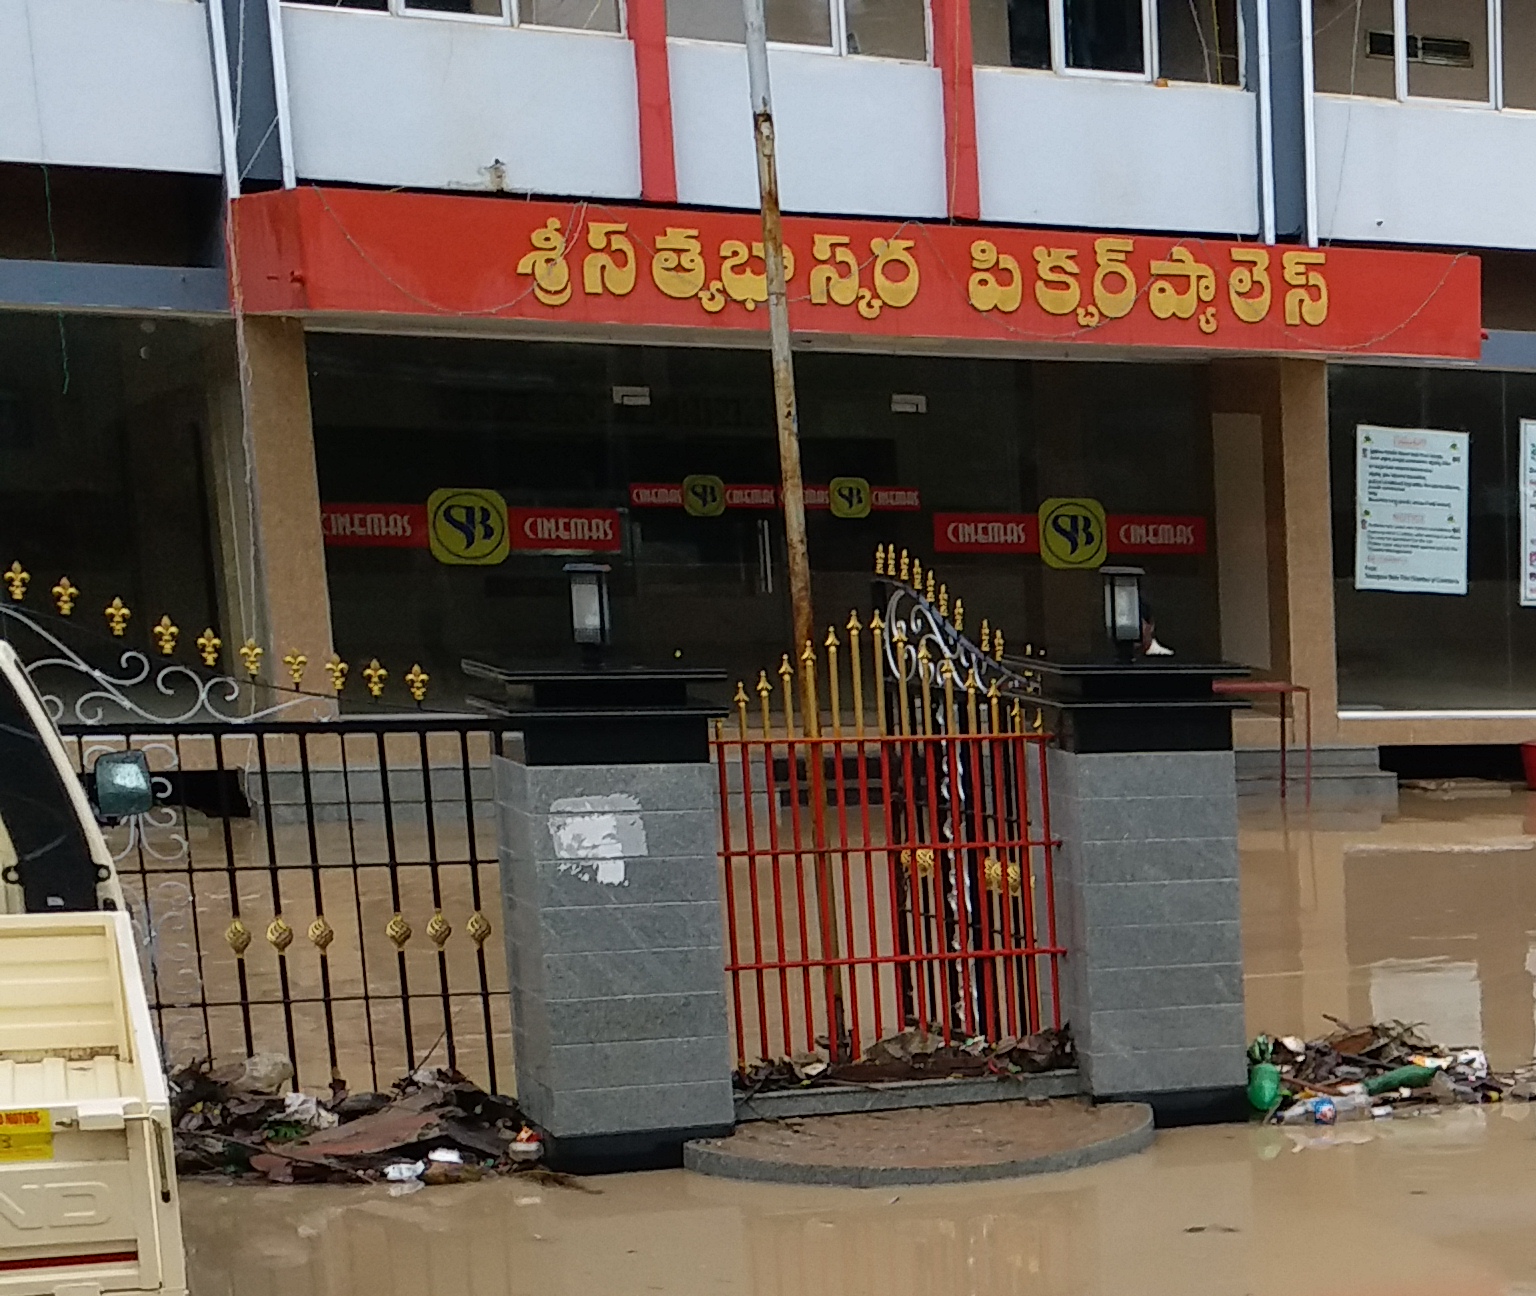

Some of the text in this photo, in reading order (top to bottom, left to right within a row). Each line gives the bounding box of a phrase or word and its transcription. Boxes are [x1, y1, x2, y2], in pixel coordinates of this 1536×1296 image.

[524, 516, 614, 541] CINEMAS
[946, 522, 1026, 544] CINEMAS
[1119, 523, 1195, 545] CINEMAS
